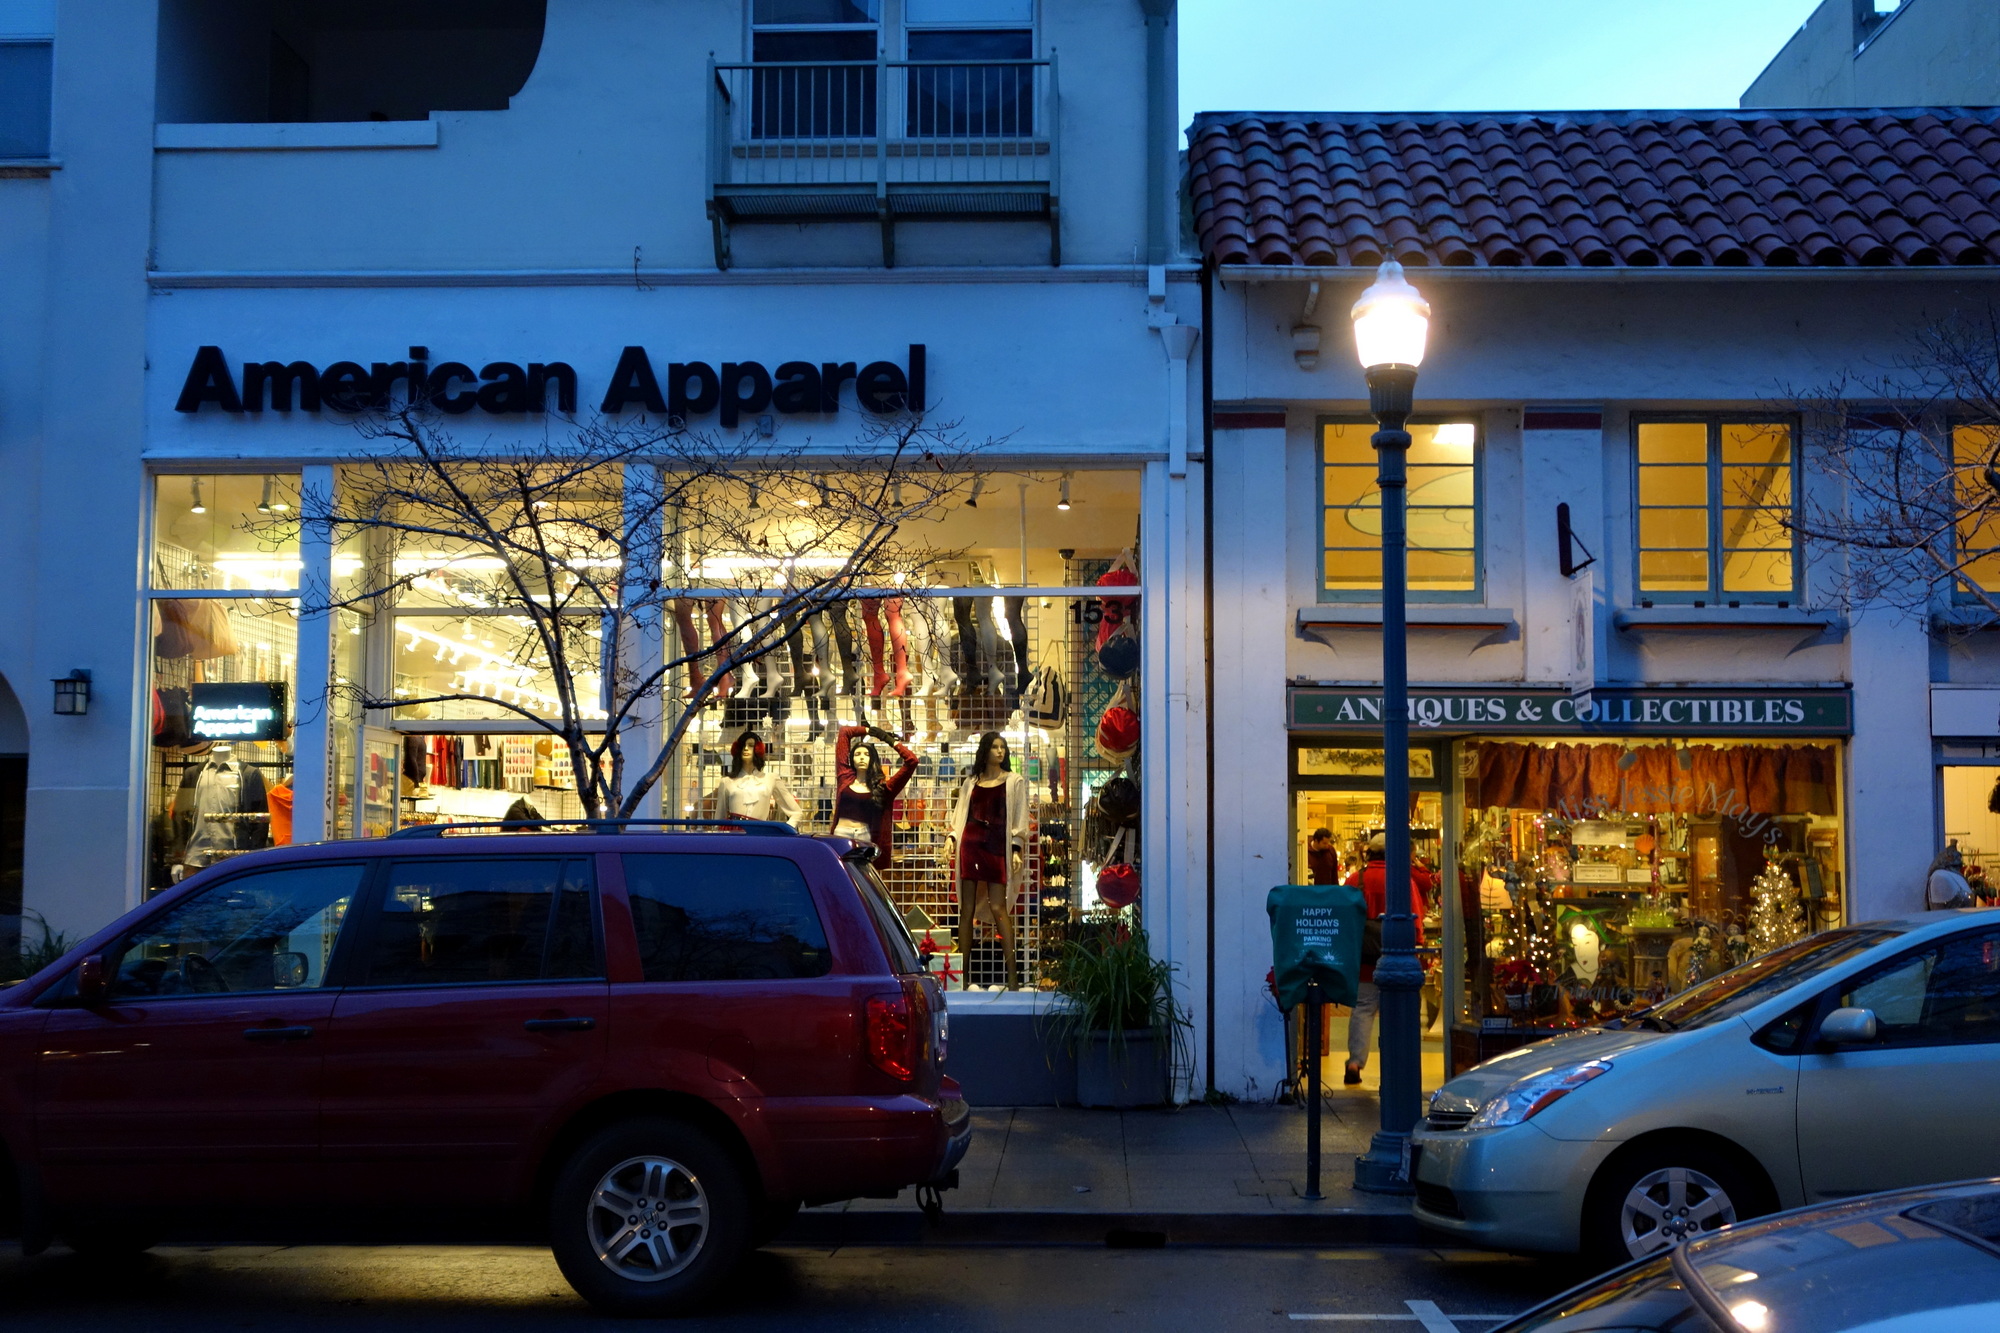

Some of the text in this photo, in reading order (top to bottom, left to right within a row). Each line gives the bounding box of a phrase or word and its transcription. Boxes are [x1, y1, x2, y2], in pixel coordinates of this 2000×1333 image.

[174, 343, 927, 428] American Apparel
[193, 705, 273, 720] American
[1334, 697, 1805, 727] ANIQUES & COLLECTIBLES
[193, 720, 257, 737] Apparel
[325, 715, 334, 810] American
[1614, 777, 1694, 818] Jessie
[1295, 918, 1339, 927] HOLIDAYS
[1302, 907, 1332, 916] HAPPY
